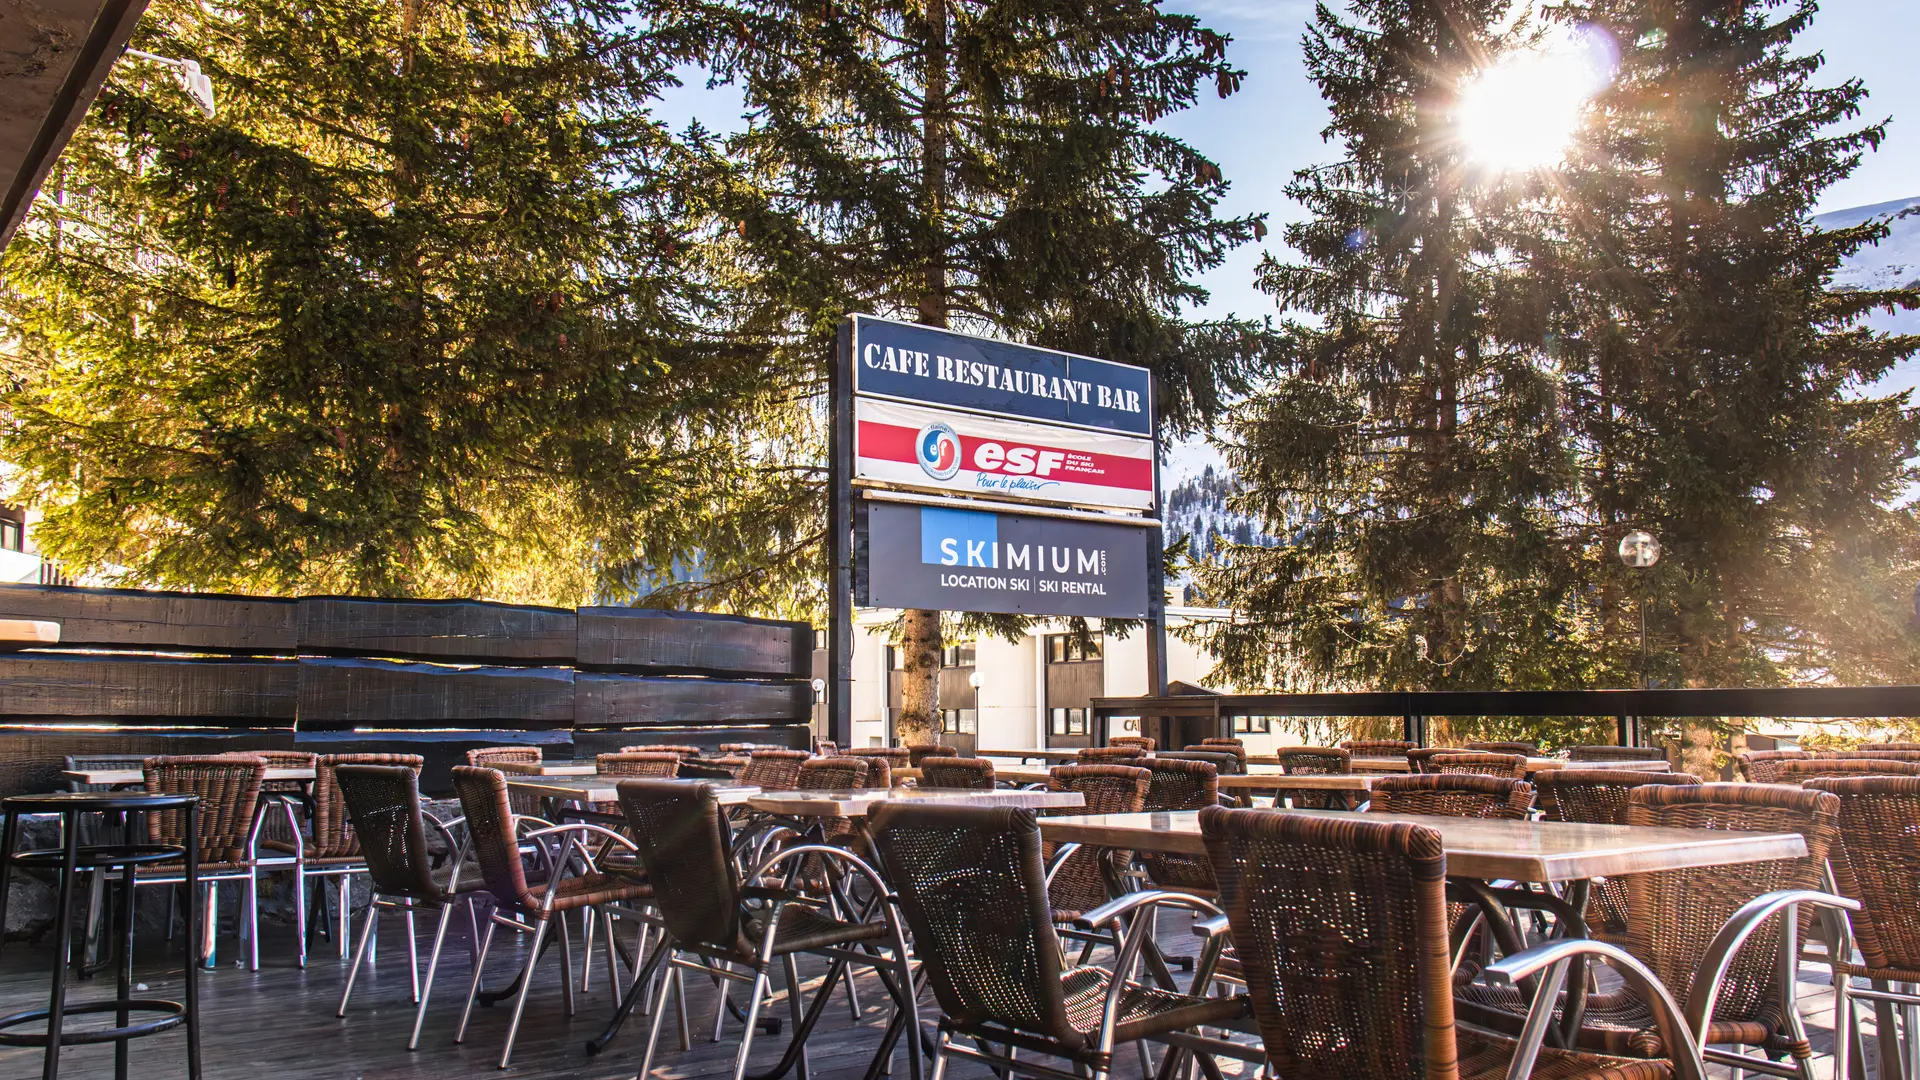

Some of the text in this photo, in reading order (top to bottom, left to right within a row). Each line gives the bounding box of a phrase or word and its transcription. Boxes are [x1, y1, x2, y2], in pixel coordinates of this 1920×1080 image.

[864, 343, 1141, 413] CAFE RESTAURANT BAR
[976, 472, 1060, 493] Pour le plaisir
[940, 537, 1099, 576] SKIMIUM
[941, 574, 1107, 596] LOCATION SKI SKI RENTAL
